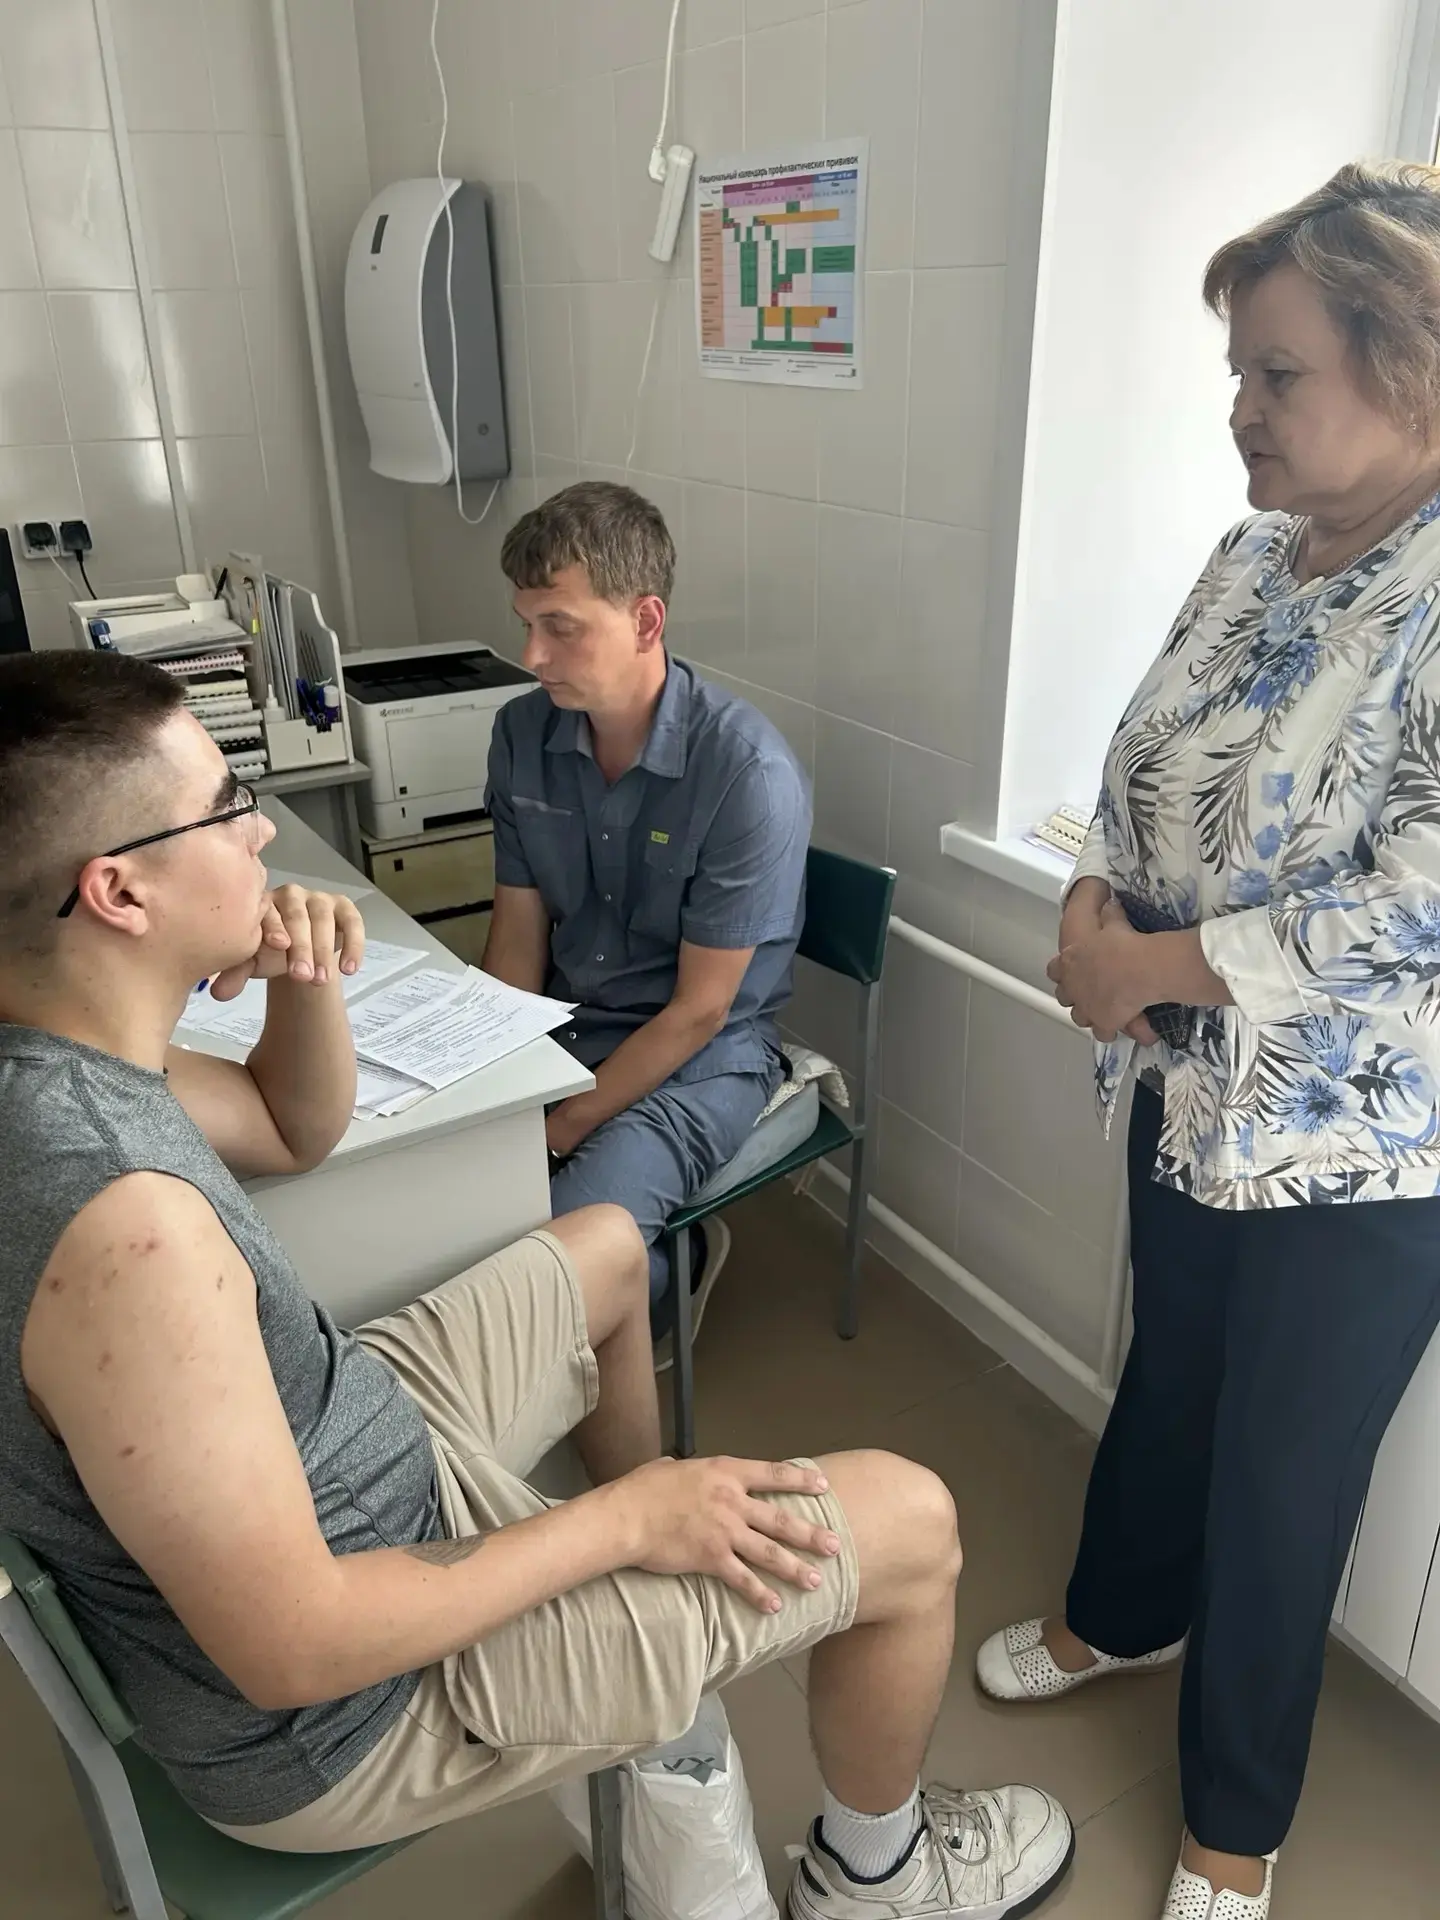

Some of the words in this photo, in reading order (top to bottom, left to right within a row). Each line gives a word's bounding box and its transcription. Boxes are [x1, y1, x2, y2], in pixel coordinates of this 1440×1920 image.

[699, 170, 737, 184] Национальный
[738, 168, 767, 180] календарь
[768, 161, 825, 177] профилактических
[826, 156, 858, 169] прививок
